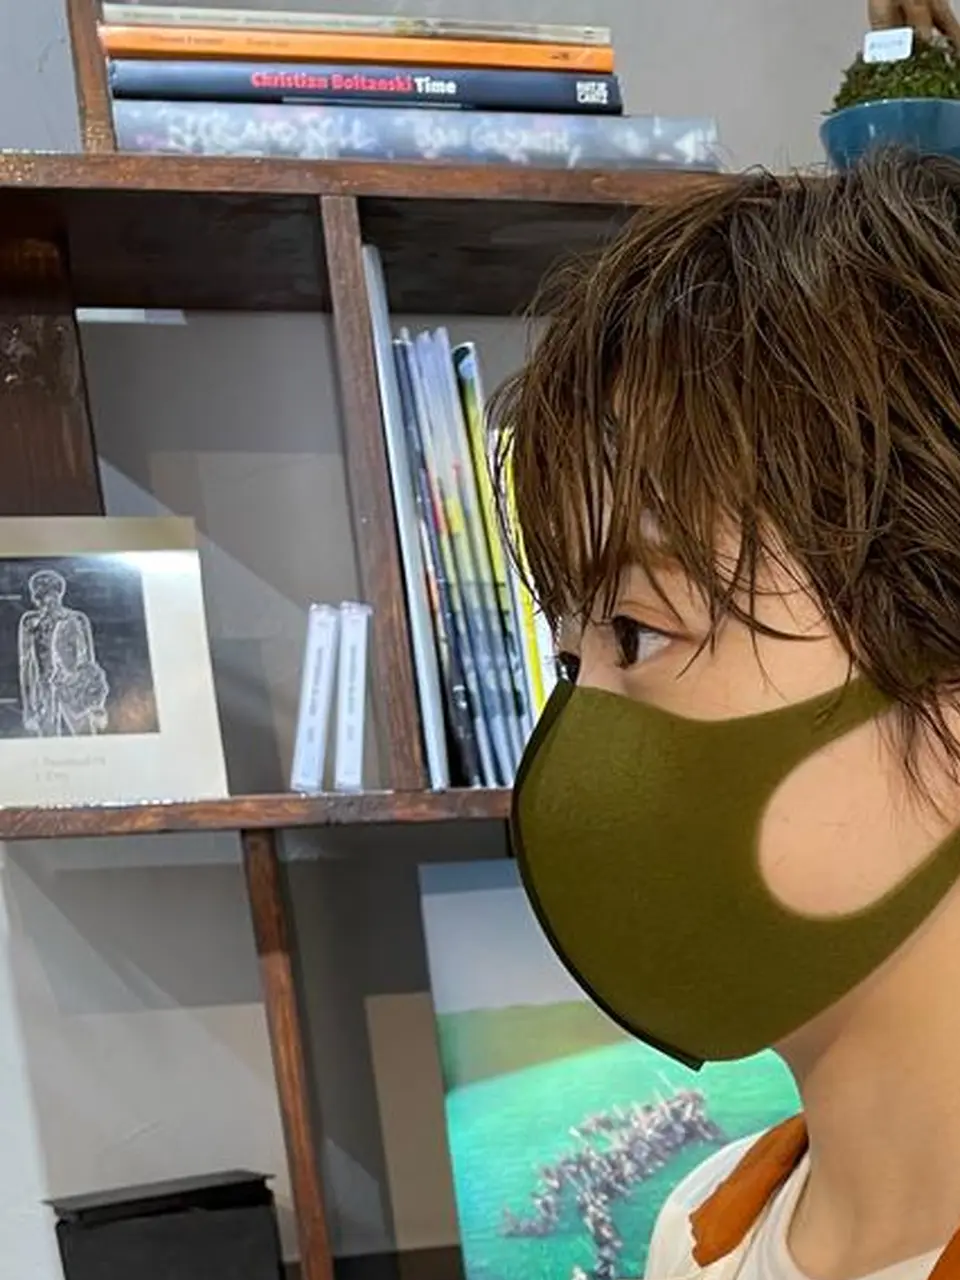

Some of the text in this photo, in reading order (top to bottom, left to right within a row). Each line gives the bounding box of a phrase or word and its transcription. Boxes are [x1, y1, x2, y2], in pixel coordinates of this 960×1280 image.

[252, 72, 456, 94] Christian Boltanski Time
